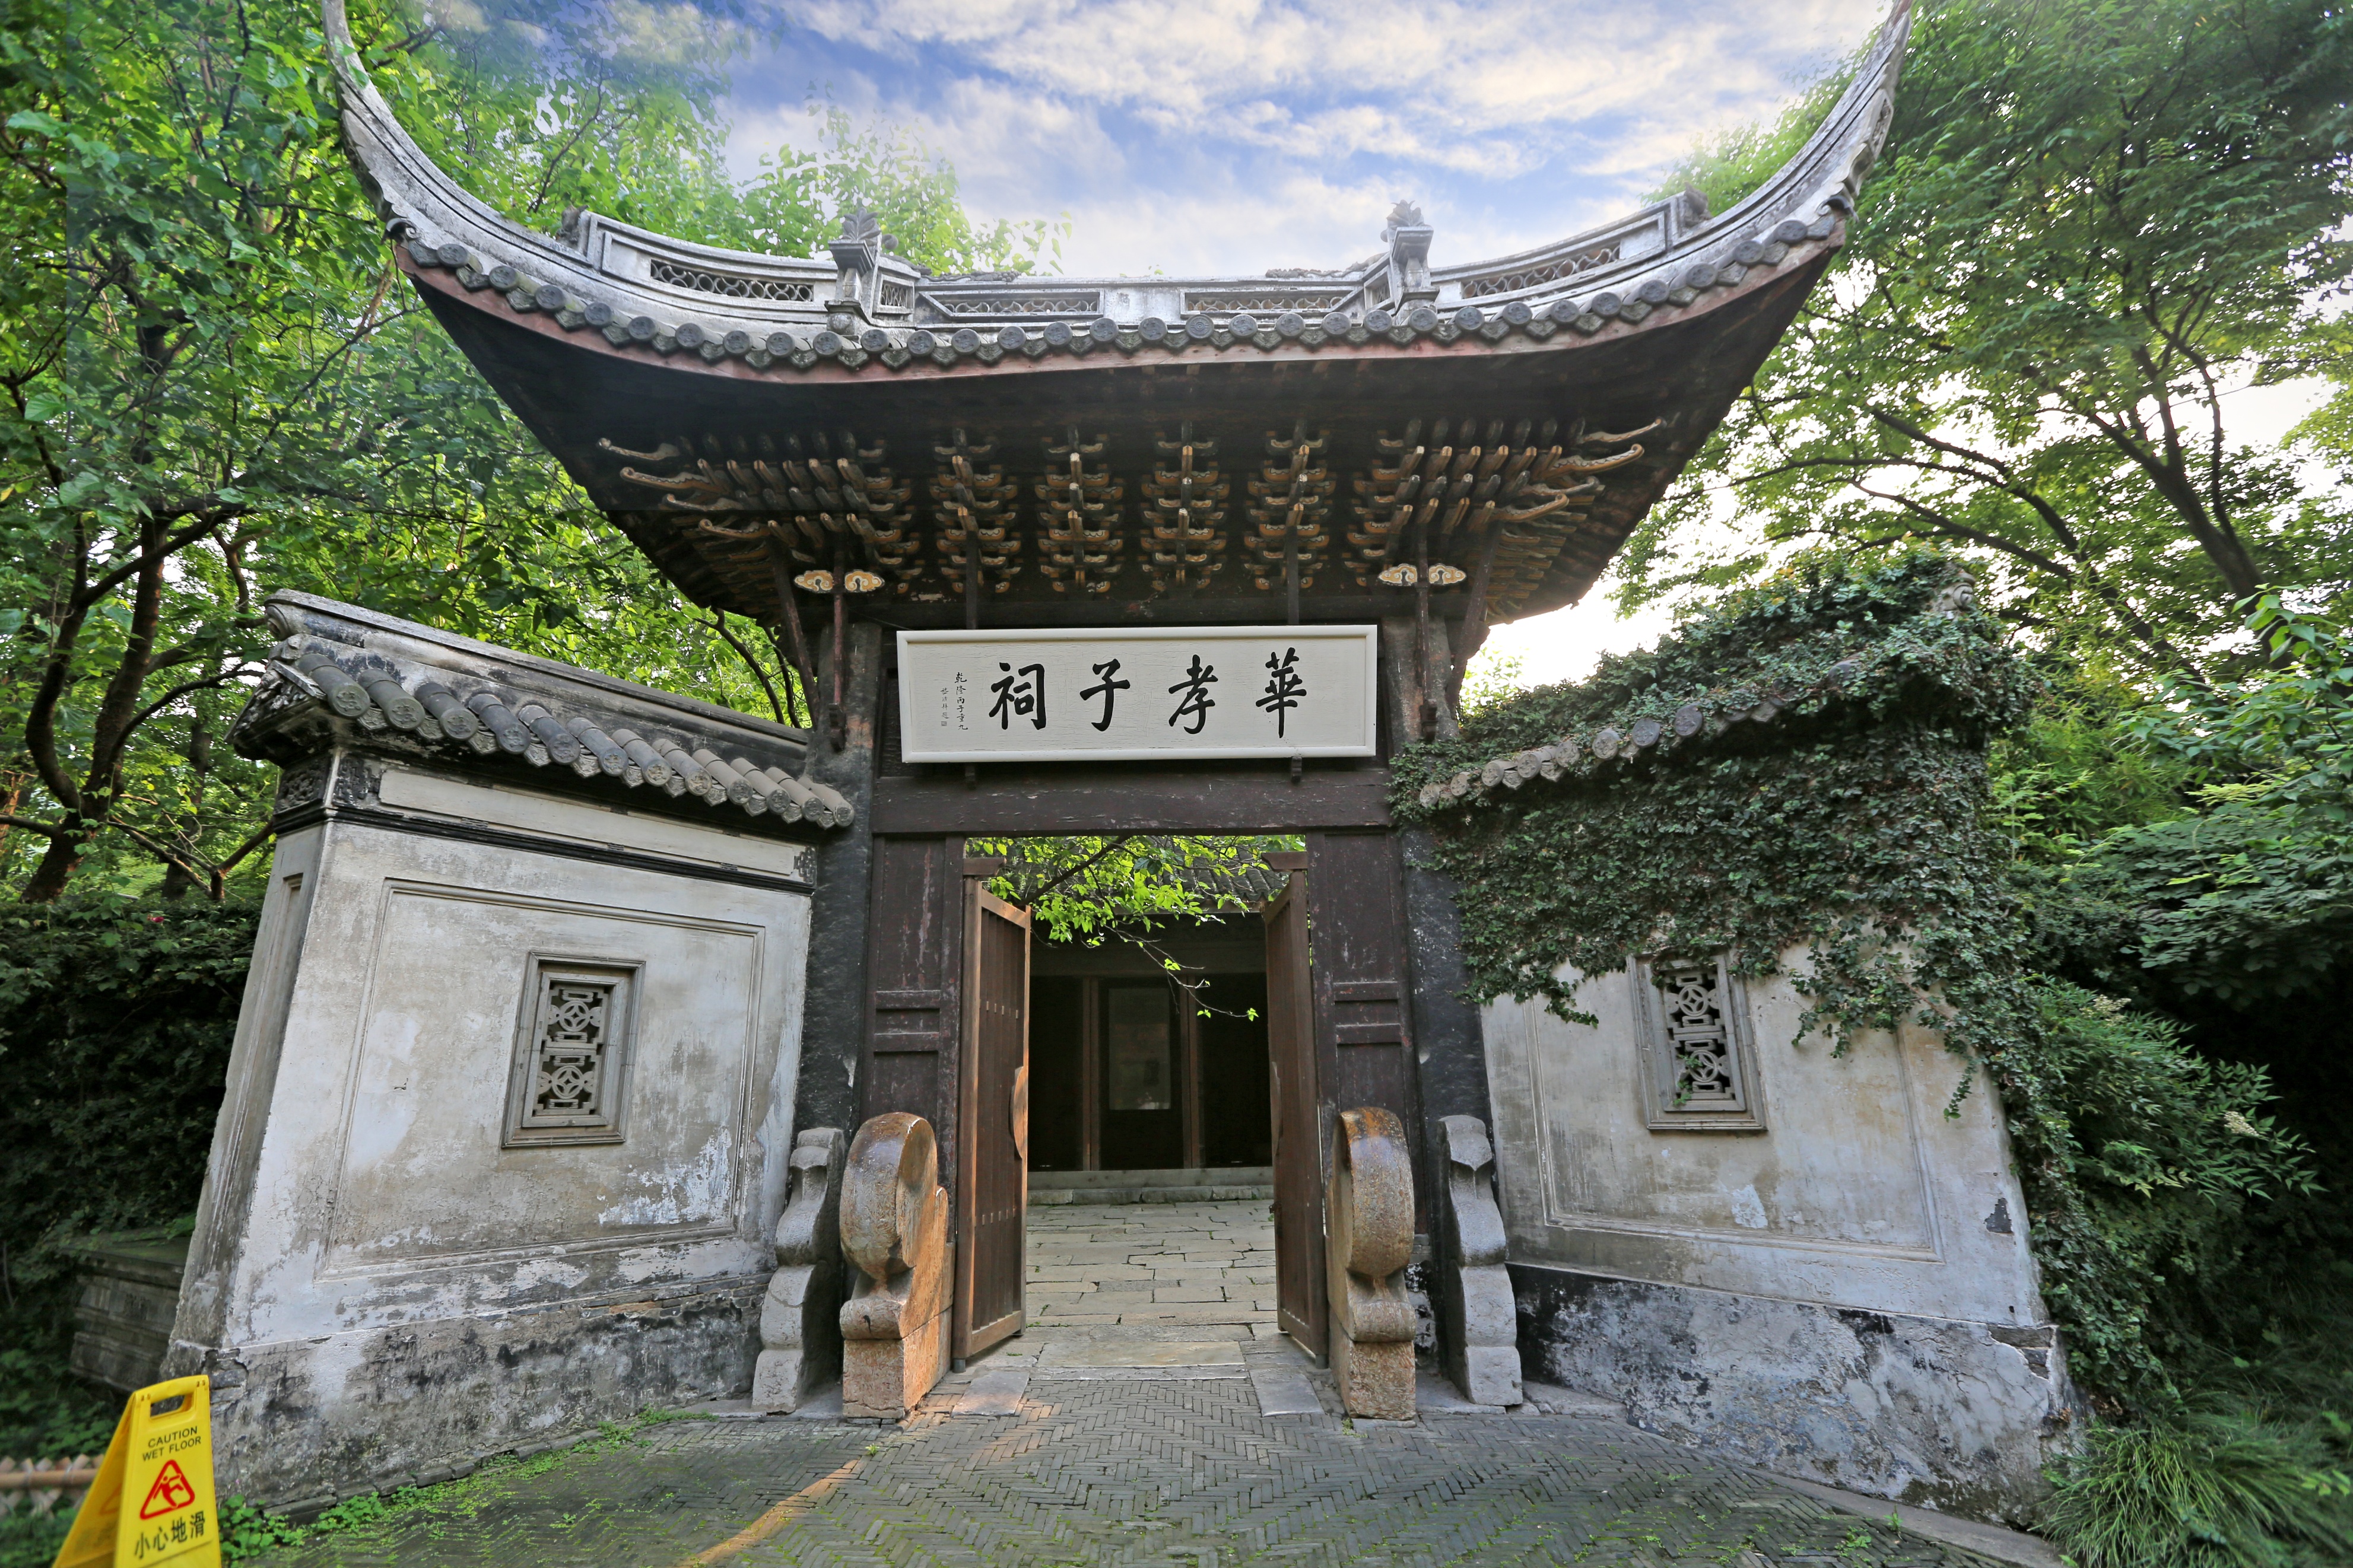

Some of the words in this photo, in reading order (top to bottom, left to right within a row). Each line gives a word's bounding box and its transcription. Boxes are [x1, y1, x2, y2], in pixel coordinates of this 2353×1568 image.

[954, 672, 968, 730] 乾隆丙子重九
[989, 647, 1307, 738] 華孝子祠
[142, 1447, 164, 1462] WET
[169, 1436, 201, 1453] FLOOR
[148, 1426, 197, 1448] CAUTION
[134, 1510, 205, 1560] 小心地滑
